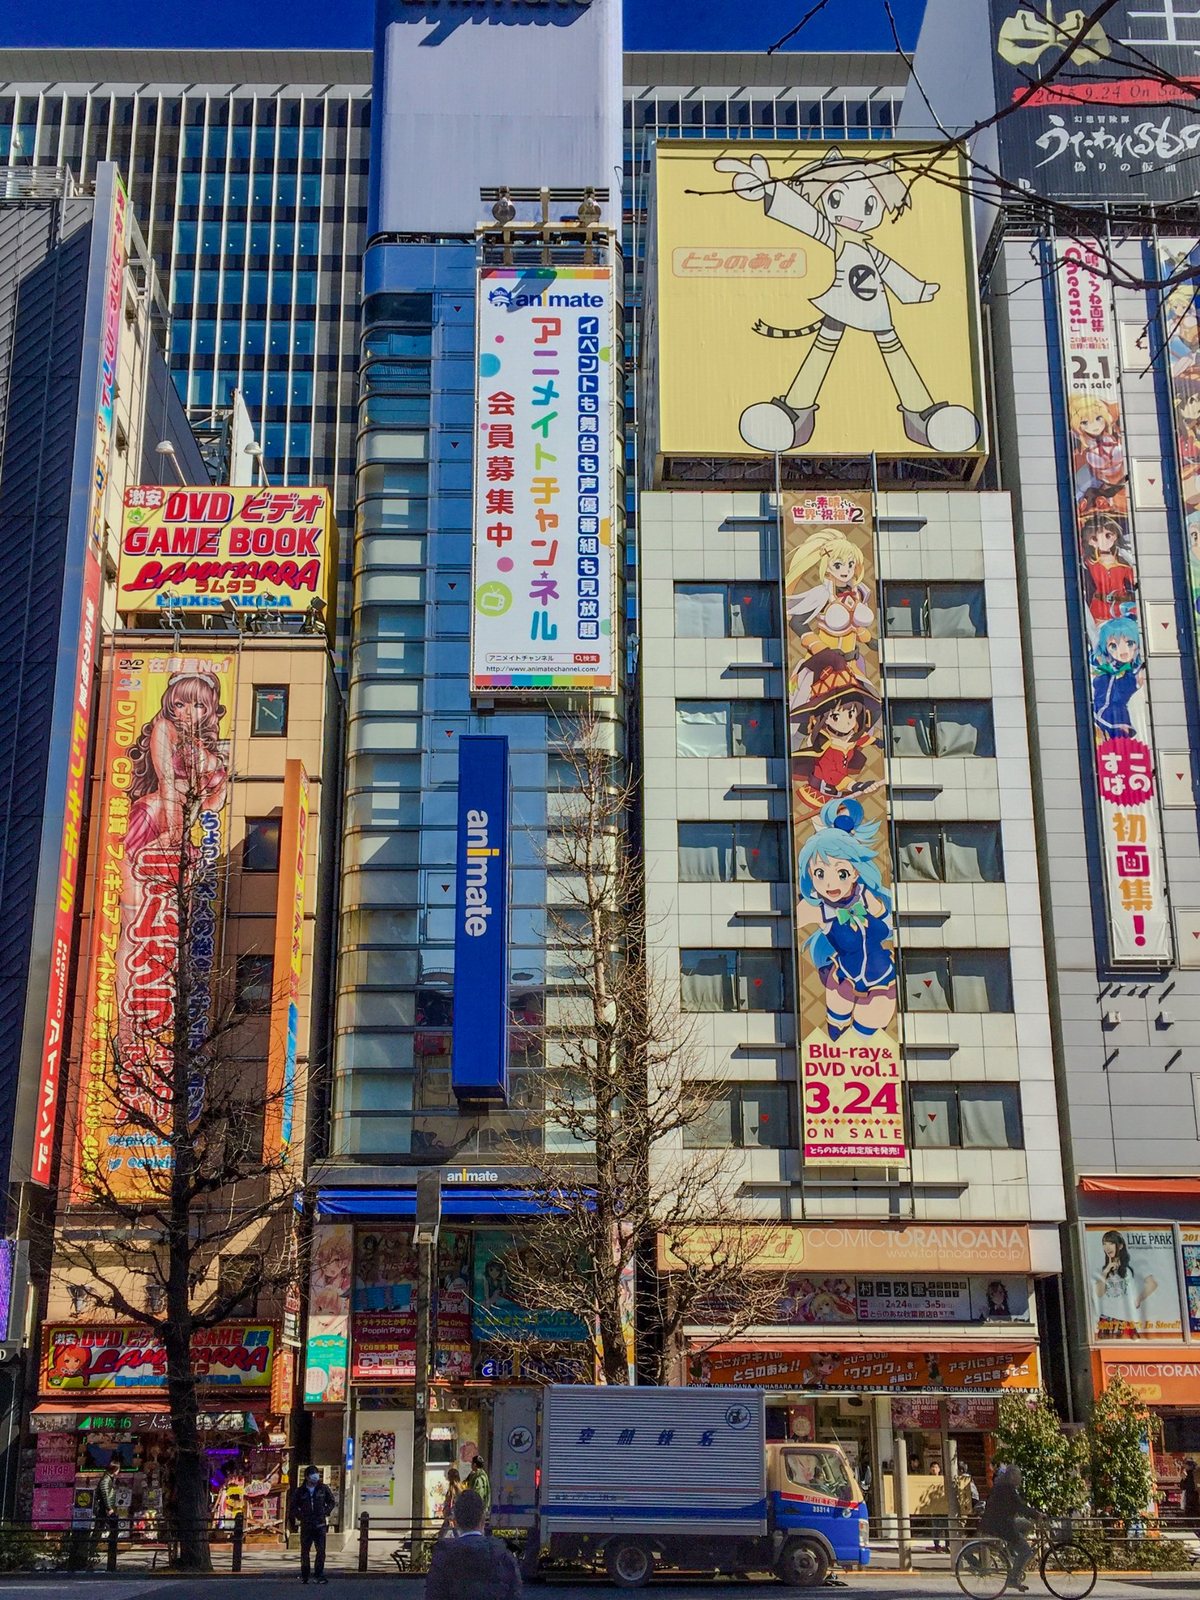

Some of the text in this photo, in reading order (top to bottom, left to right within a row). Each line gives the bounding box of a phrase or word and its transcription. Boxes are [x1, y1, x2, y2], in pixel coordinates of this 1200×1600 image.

[681, 252, 798, 270] とらのあな
[516, 289, 604, 308] animate
[1071, 356, 1111, 379] 2.1
[1073, 380, 1113, 389] on sale
[485, 391, 515, 548] 会員募集中
[529, 317, 561, 640] アニメイトチャンネル
[578, 317, 599, 640] イベントも舞台も声優番組も見放題
[128, 489, 162, 507] 激安
[163, 492, 324, 523] DVD ビデオ
[123, 527, 322, 556] GAME BOOK
[115, 700, 137, 747] DVD
[111, 757, 132, 789] CD
[465, 810, 500, 937] animate
[1113, 812, 1153, 946] 初画集!
[809, 1043, 892, 1061] Blu-ray&
[805, 1062, 899, 1077] DVD vol.1
[37, 1018, 61, 1172] アイランド
[805, 1081, 901, 1115] 3.24
[807, 1128, 902, 1139] ON SALE
[447, 1168, 498, 1182] animate
[1127, 1232, 1173, 1246] LIVE PARK
[80, 1331, 122, 1346] DVD
